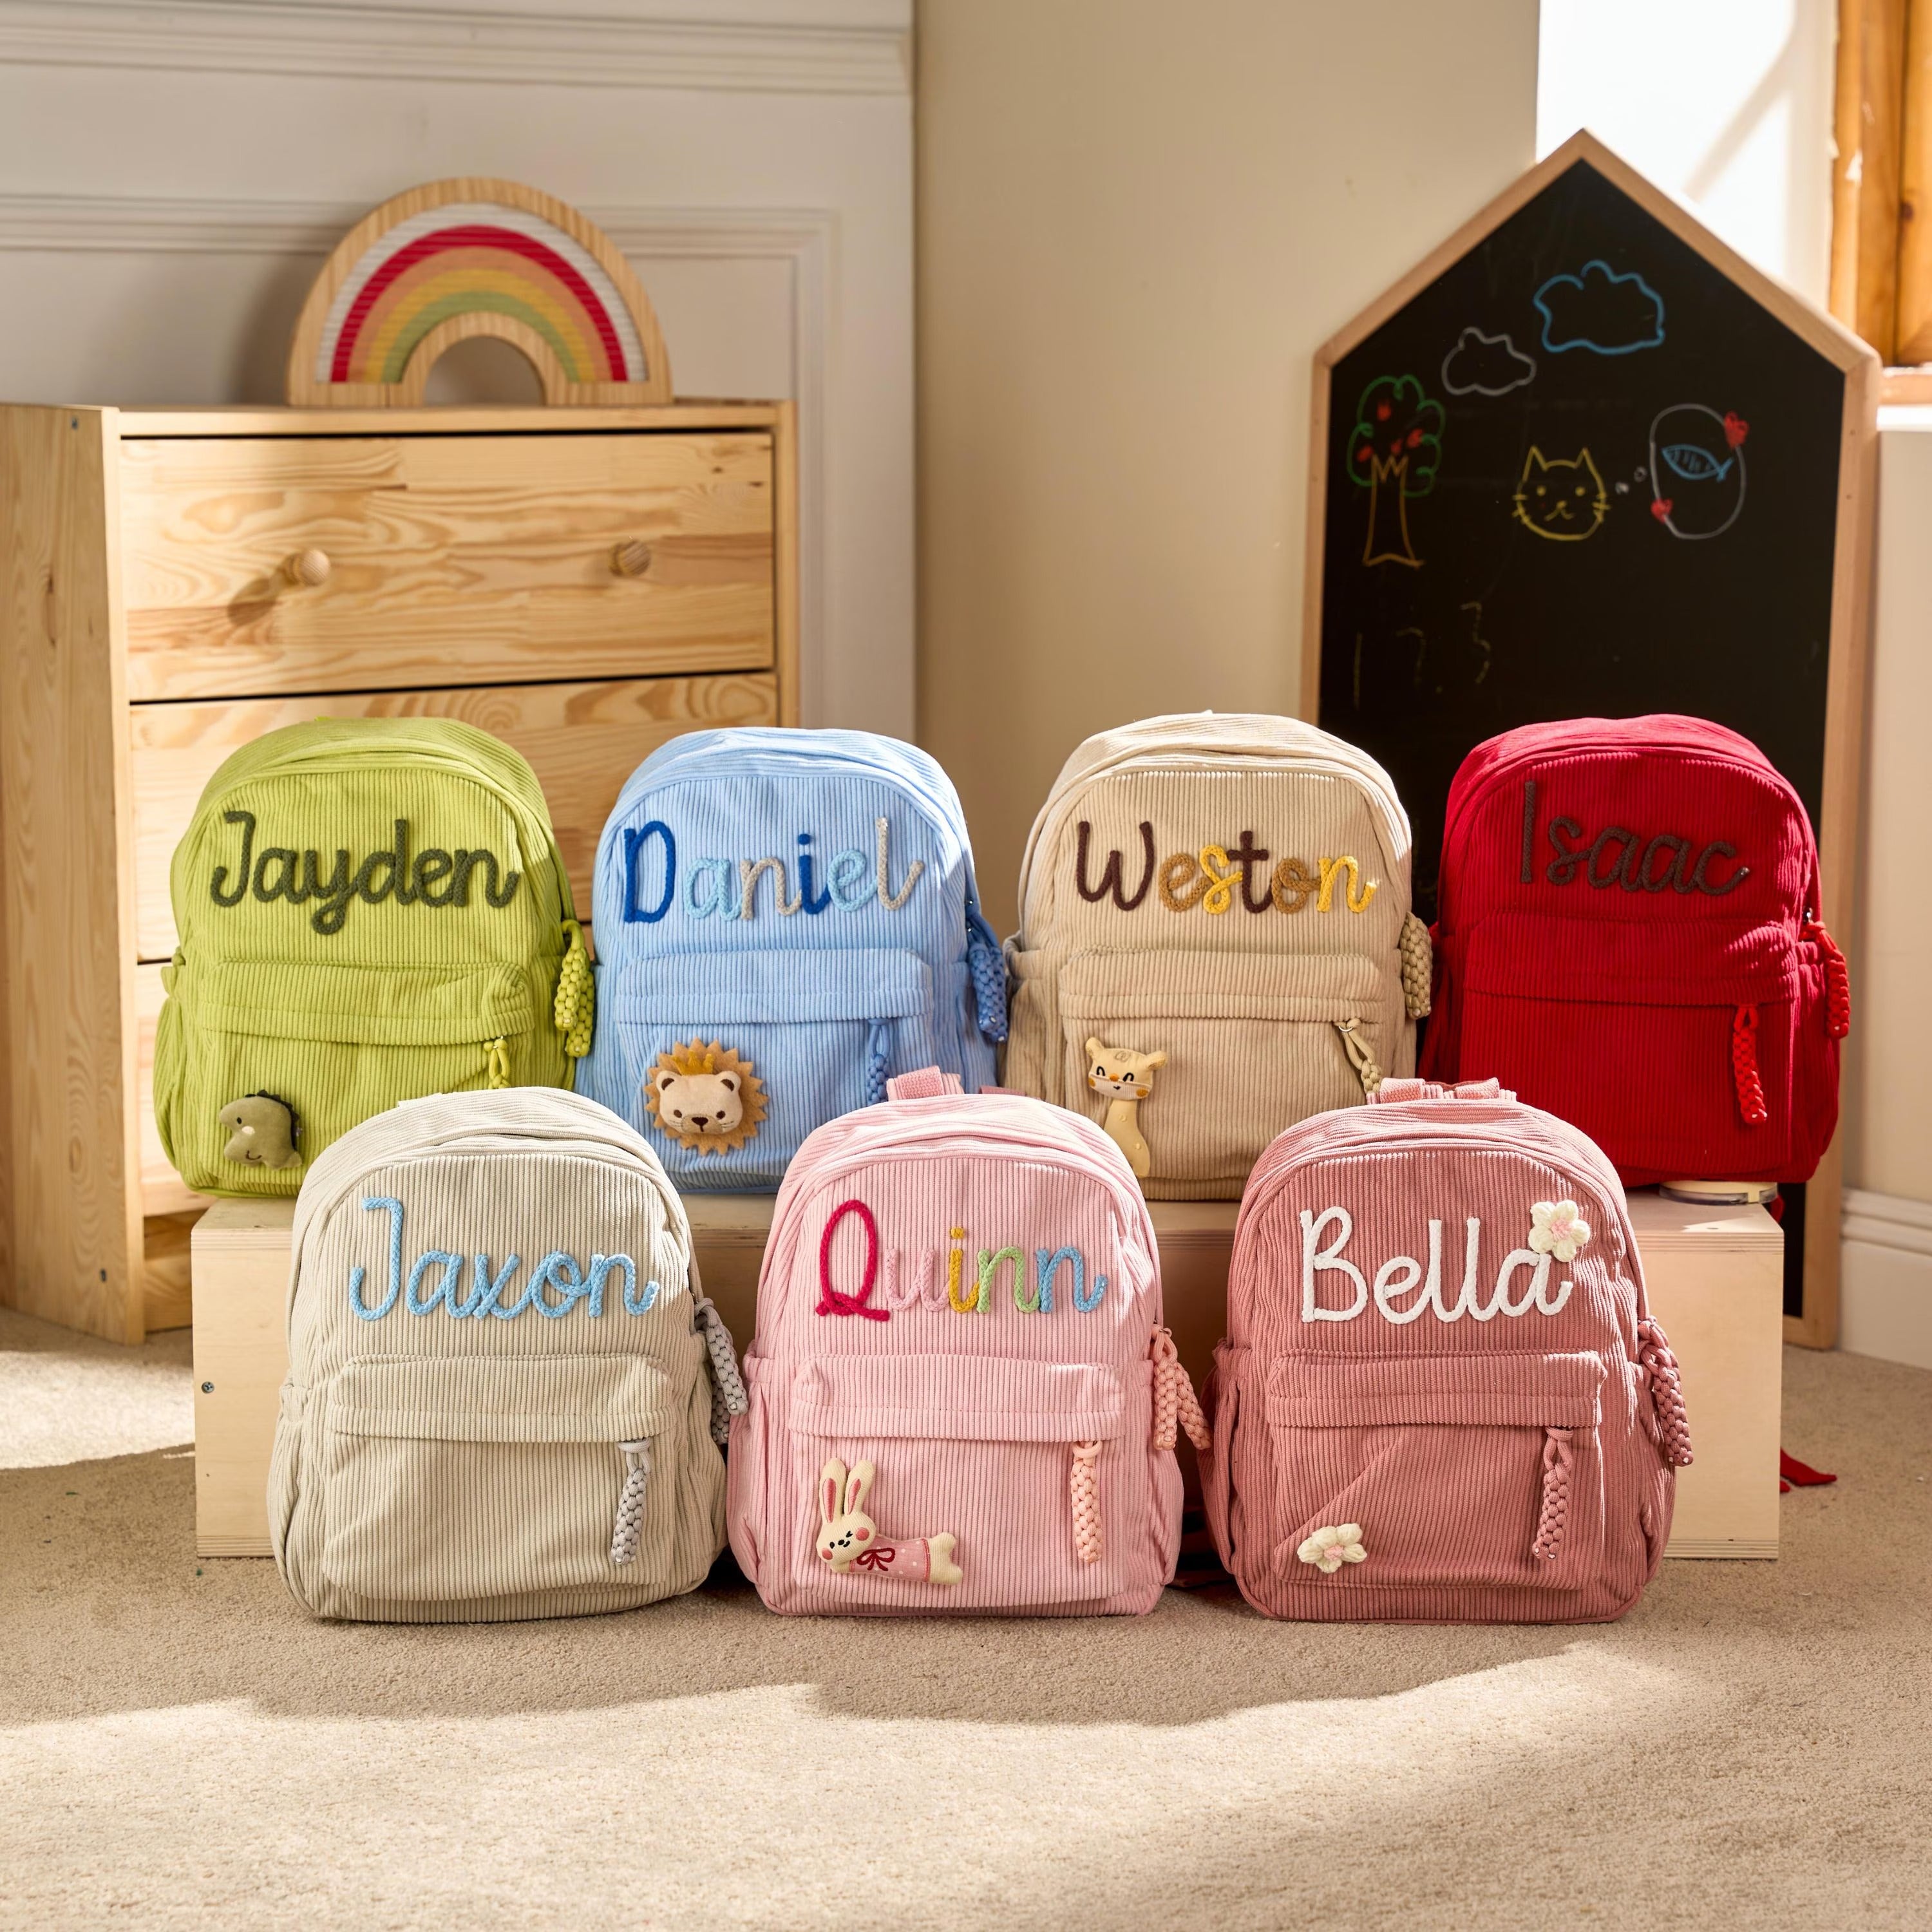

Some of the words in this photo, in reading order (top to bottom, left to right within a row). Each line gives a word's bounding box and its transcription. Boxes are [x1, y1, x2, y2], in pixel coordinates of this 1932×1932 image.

[211, 811, 519, 934] Jayden
[623, 818, 925, 923] Daniel
[1077, 820, 1377, 914] Weston
[1521, 781, 1750, 895] Isaac
[350, 1197, 659, 1321] Jaxon
[815, 1199, 1108, 1321] Quinn
[1300, 1206, 1573, 1323] Bella
